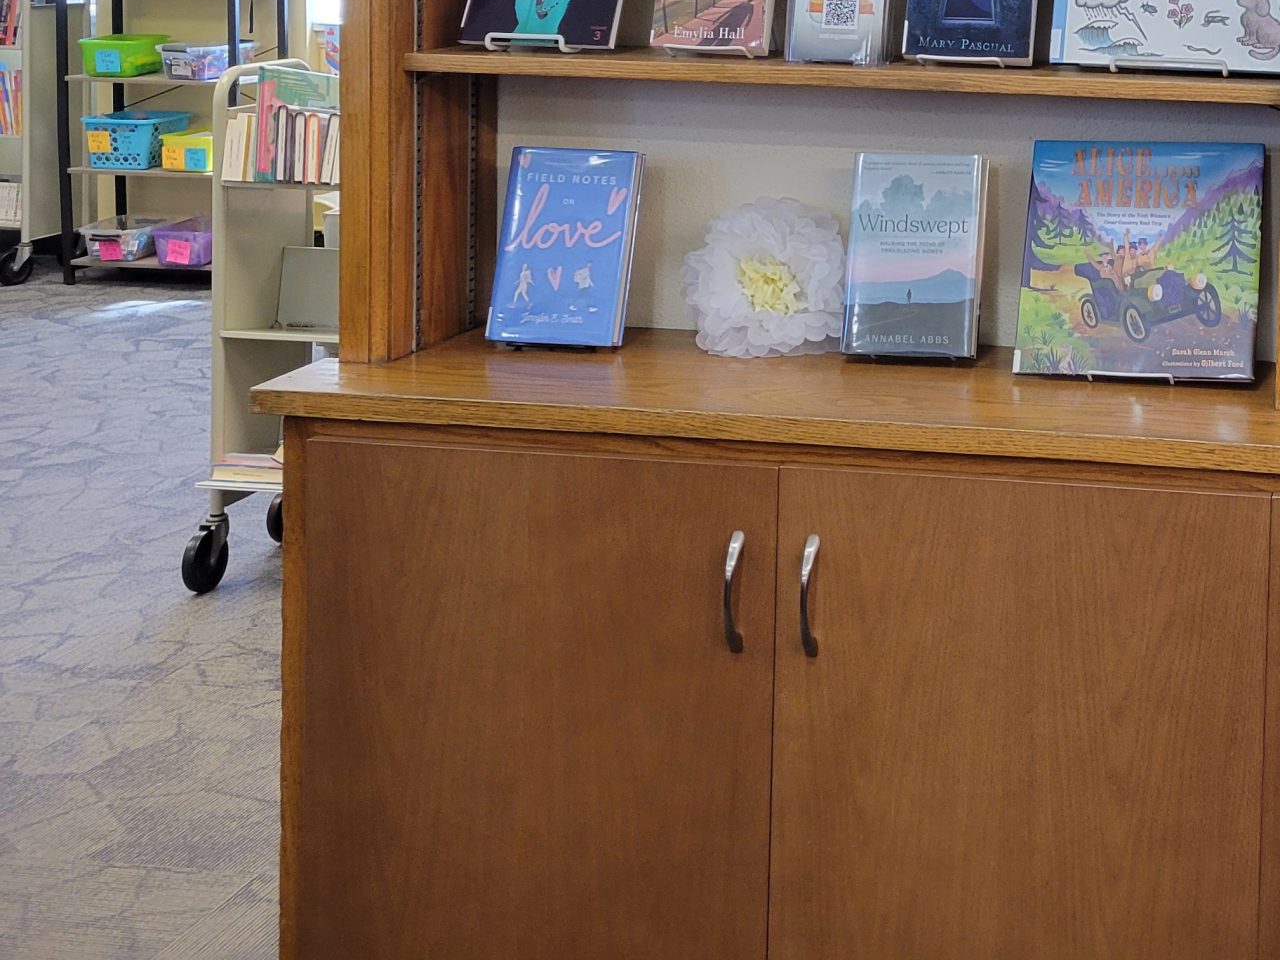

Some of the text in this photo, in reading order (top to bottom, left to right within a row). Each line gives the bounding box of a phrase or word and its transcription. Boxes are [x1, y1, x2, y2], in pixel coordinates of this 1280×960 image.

[592, 30, 601, 41] 3
[674, 26, 745, 41] Emylia Hall
[918, 36, 1015, 53] MARY PASCUAL
[1071, 145, 1152, 177] ALICE
[527, 172, 617, 185] FIELD NOTES
[1073, 177, 1200, 209] AMERICA
[504, 183, 622, 252] love
[859, 214, 969, 239] Windswept
[865, 335, 949, 344] ANNABEL ABBS
[1171, 348, 1235, 357] Sarah Glenn Marsh
[1201, 359, 1226, 368] Gilbert
[1227, 360, 1244, 368] Ford
